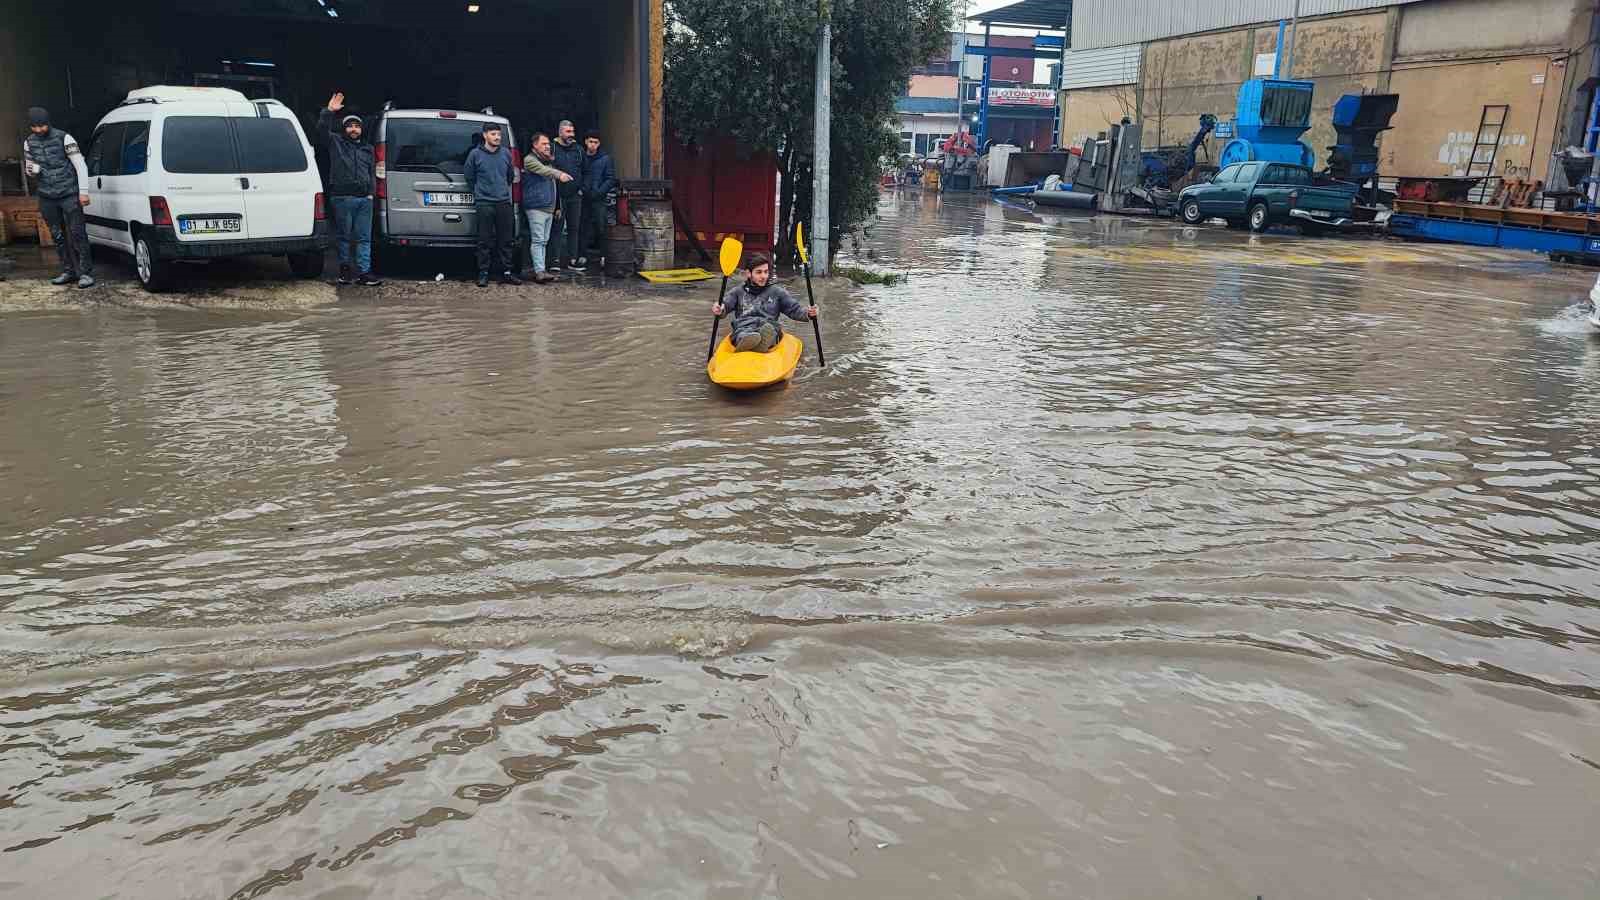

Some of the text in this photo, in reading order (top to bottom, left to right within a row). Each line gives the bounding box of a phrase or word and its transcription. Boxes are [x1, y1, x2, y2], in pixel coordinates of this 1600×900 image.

[429, 194, 438, 202] 01
[186, 220, 197, 230] 01
[205, 219, 220, 229] AJK
